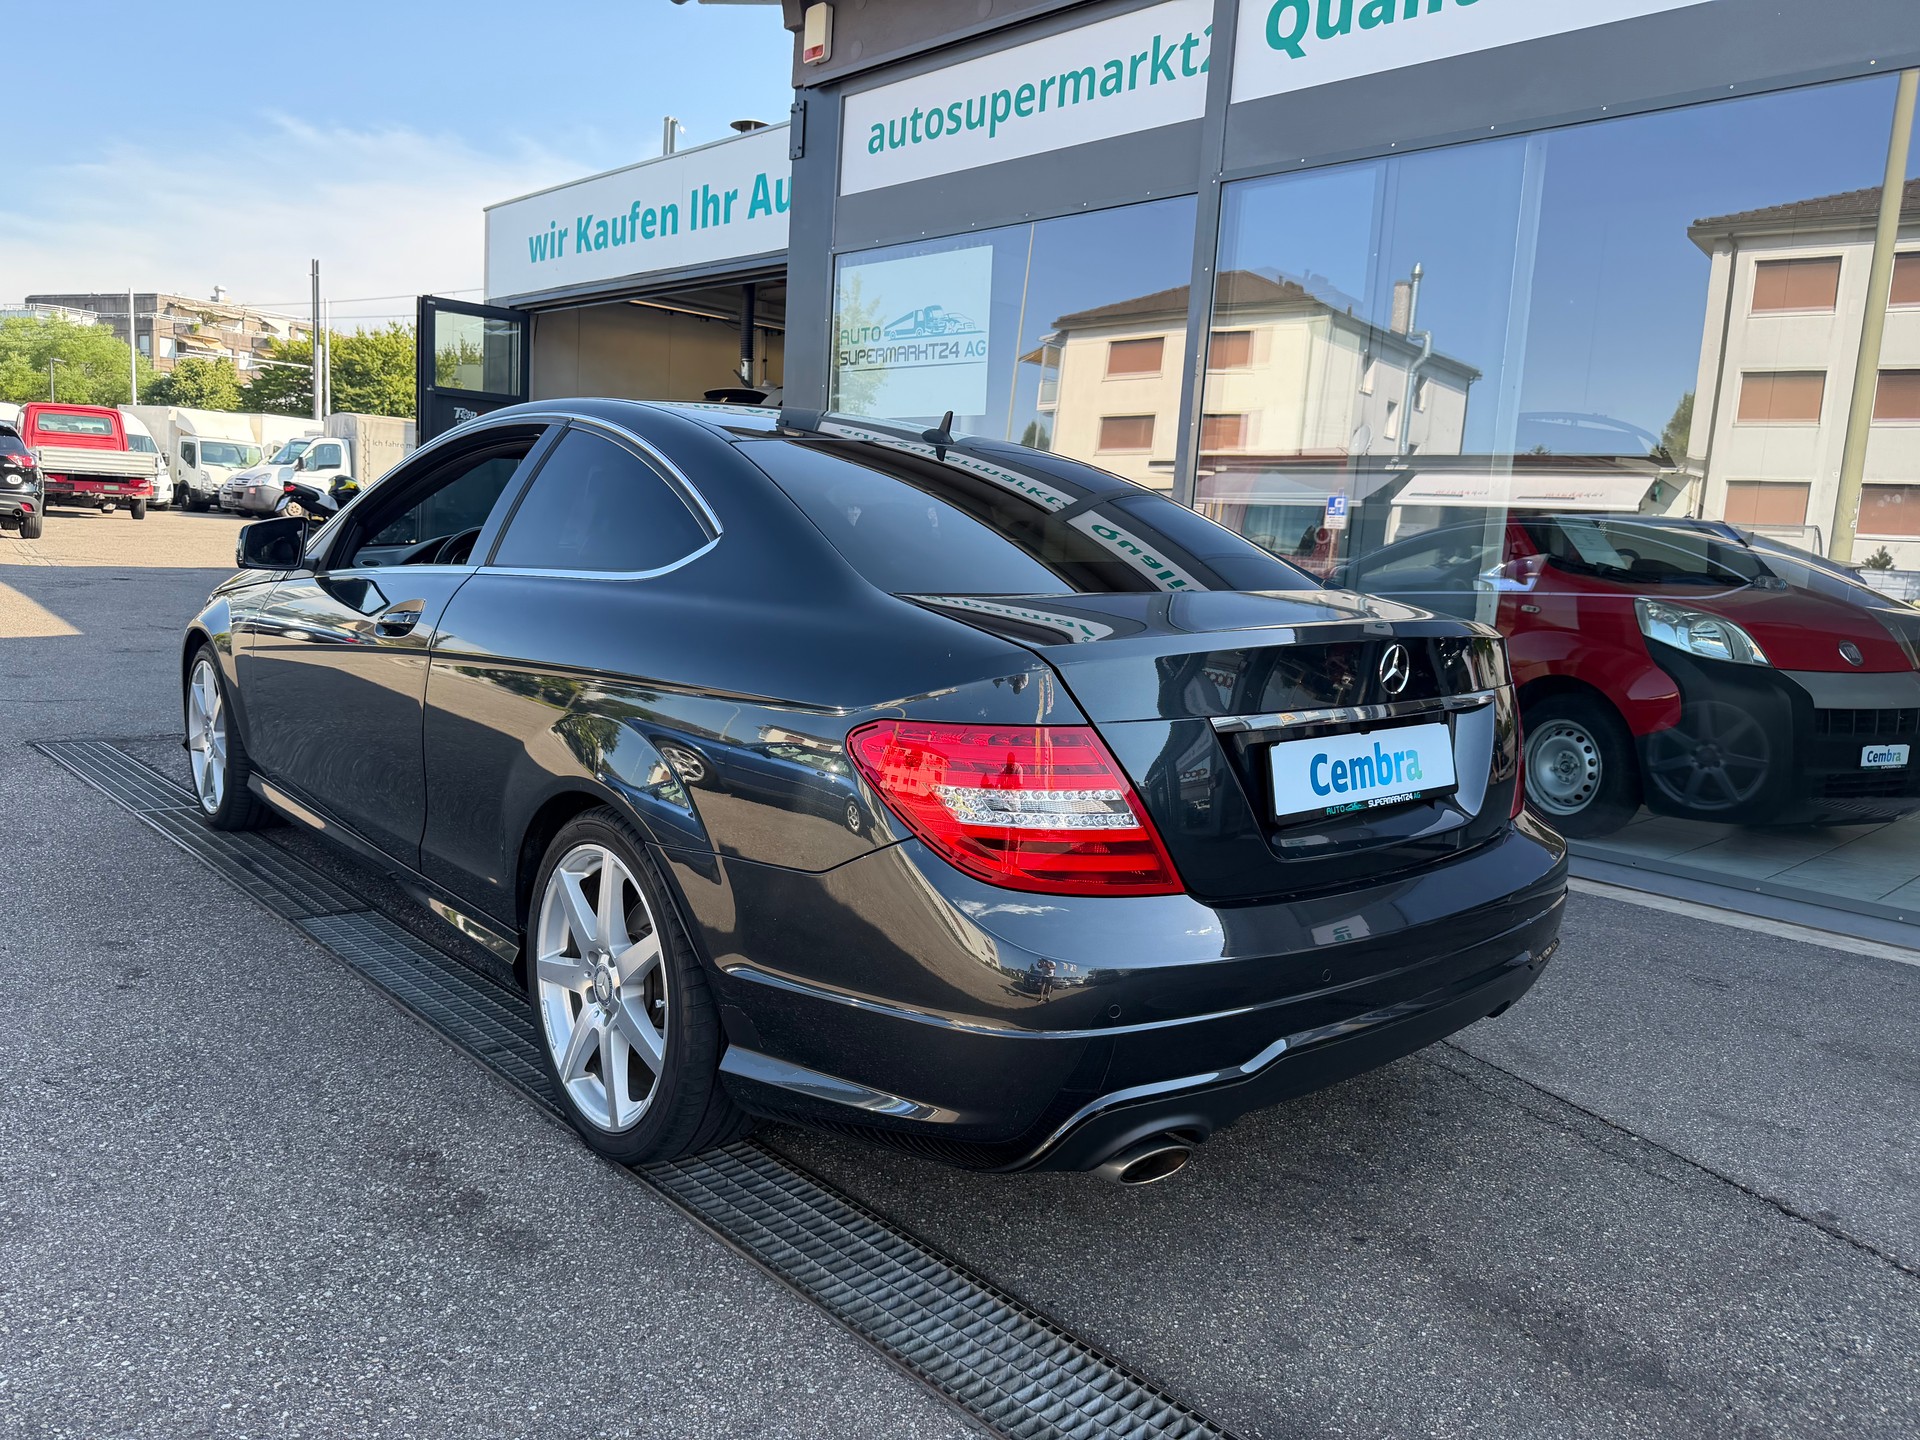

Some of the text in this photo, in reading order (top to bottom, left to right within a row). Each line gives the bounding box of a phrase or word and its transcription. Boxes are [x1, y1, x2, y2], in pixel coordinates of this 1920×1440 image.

[528, 220, 568, 264] wir
[575, 200, 679, 254] Kaufen
[690, 183, 739, 231] Ihr
[840, 326, 882, 346] AUTO
[964, 340, 987, 358] AG
[1866, 749, 1902, 763] Cembra
[1310, 741, 1422, 796] Cembra
[1326, 805, 1345, 816] AUTO
[1413, 791, 1421, 799] AG
